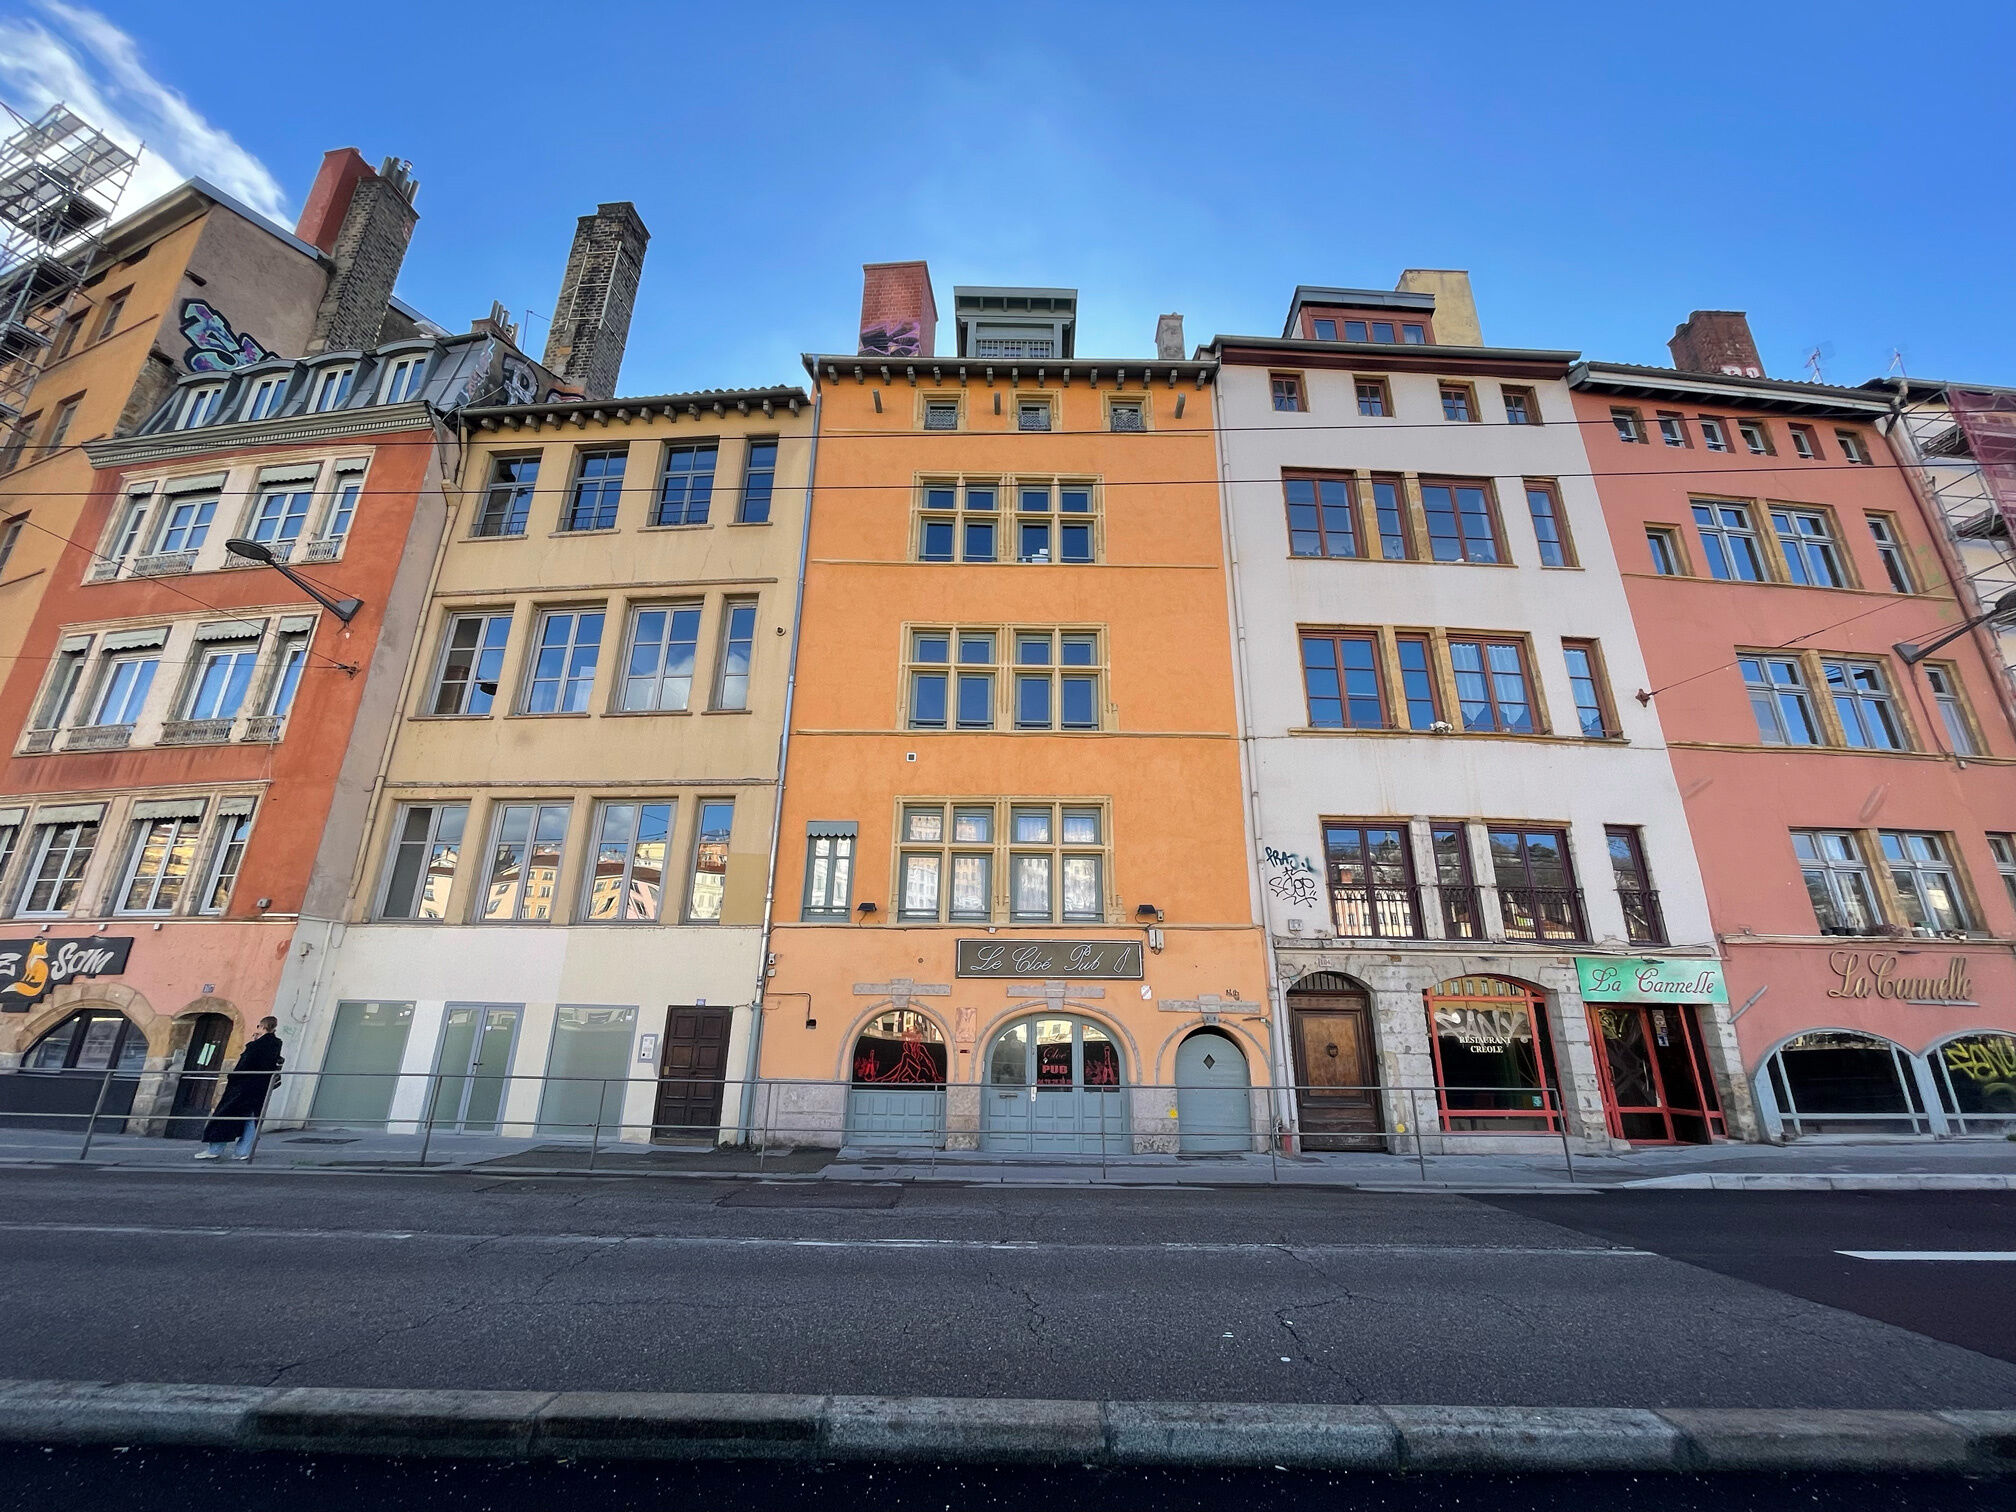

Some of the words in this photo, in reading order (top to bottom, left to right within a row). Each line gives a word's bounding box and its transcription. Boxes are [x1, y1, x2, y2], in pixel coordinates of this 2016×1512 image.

[970, 944, 1006, 972] Le
[1011, 945, 1053, 973] Cloé
[1063, 943, 1105, 972] Pub
[1588, 966, 1622, 993] La
[1634, 967, 1716, 994] Cannelle
[1828, 950, 1872, 999] La
[1867, 952, 1974, 1001] Cannelle
[1459, 1036, 1512, 1044] RESTAURANT
[1041, 1064, 1068, 1074] PUB
